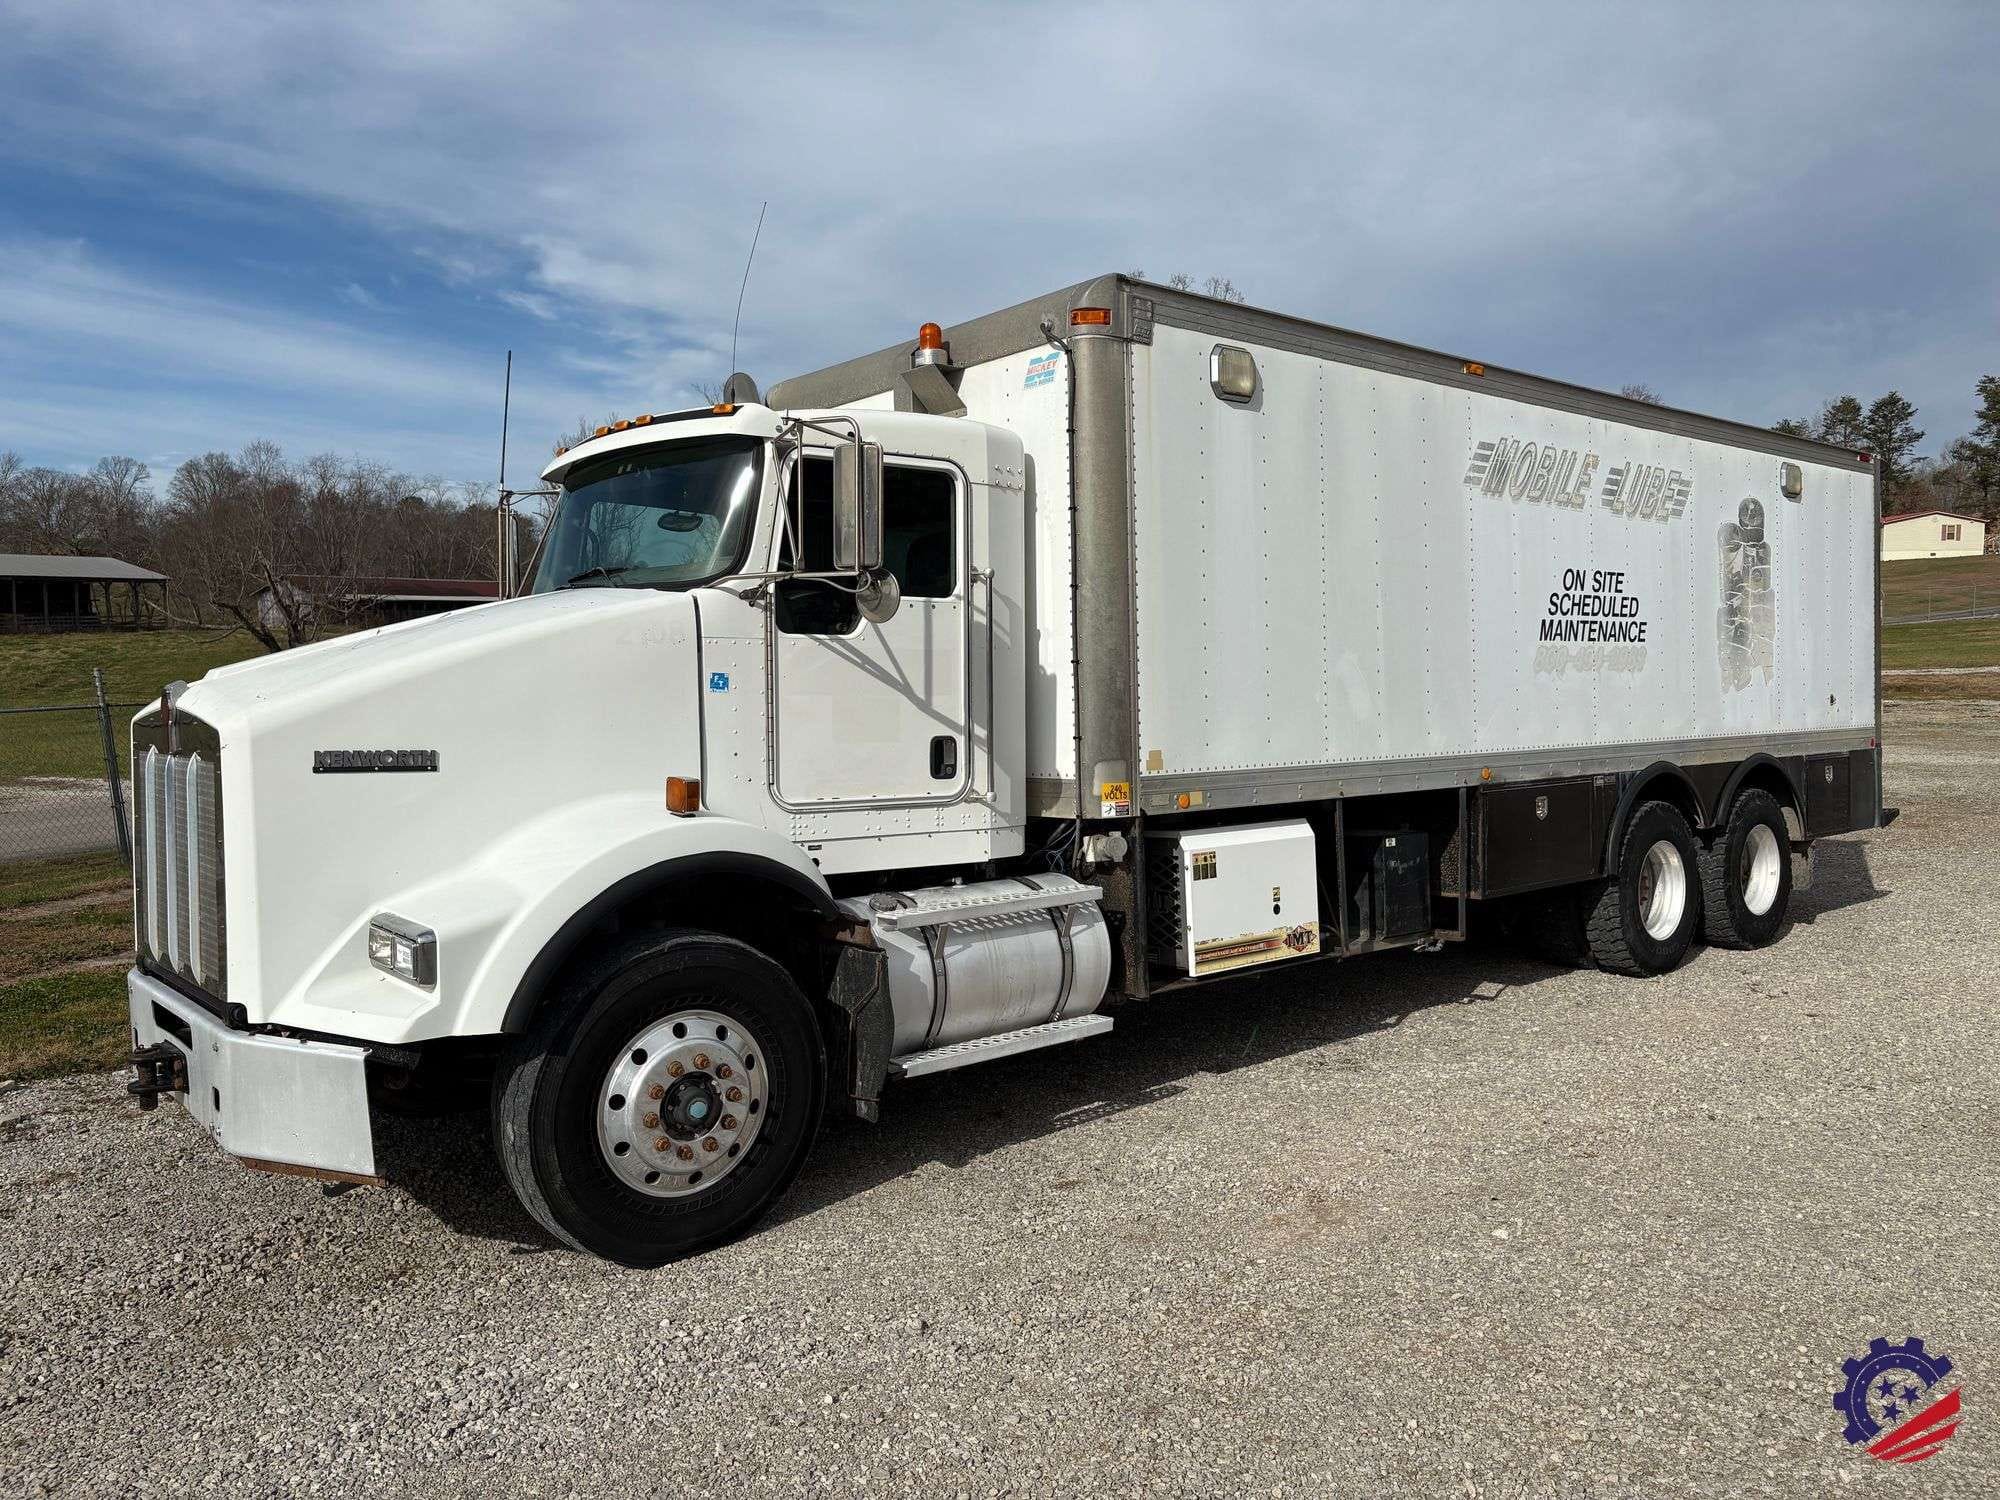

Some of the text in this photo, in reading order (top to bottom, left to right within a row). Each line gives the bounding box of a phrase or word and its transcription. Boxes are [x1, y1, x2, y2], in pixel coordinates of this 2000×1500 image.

[1026, 359, 1058, 376] MICKEY
[1481, 437, 1683, 524] MOBILE LUBE
[1562, 568, 1625, 594] ON SITE
[1547, 592, 1640, 618] SCHEDULED
[1538, 619, 1648, 643] MAINTENANCE
[313, 749, 439, 768] KENWORTH
[1103, 791, 1128, 800] VOLTS
[1286, 930, 1314, 948] IMT
